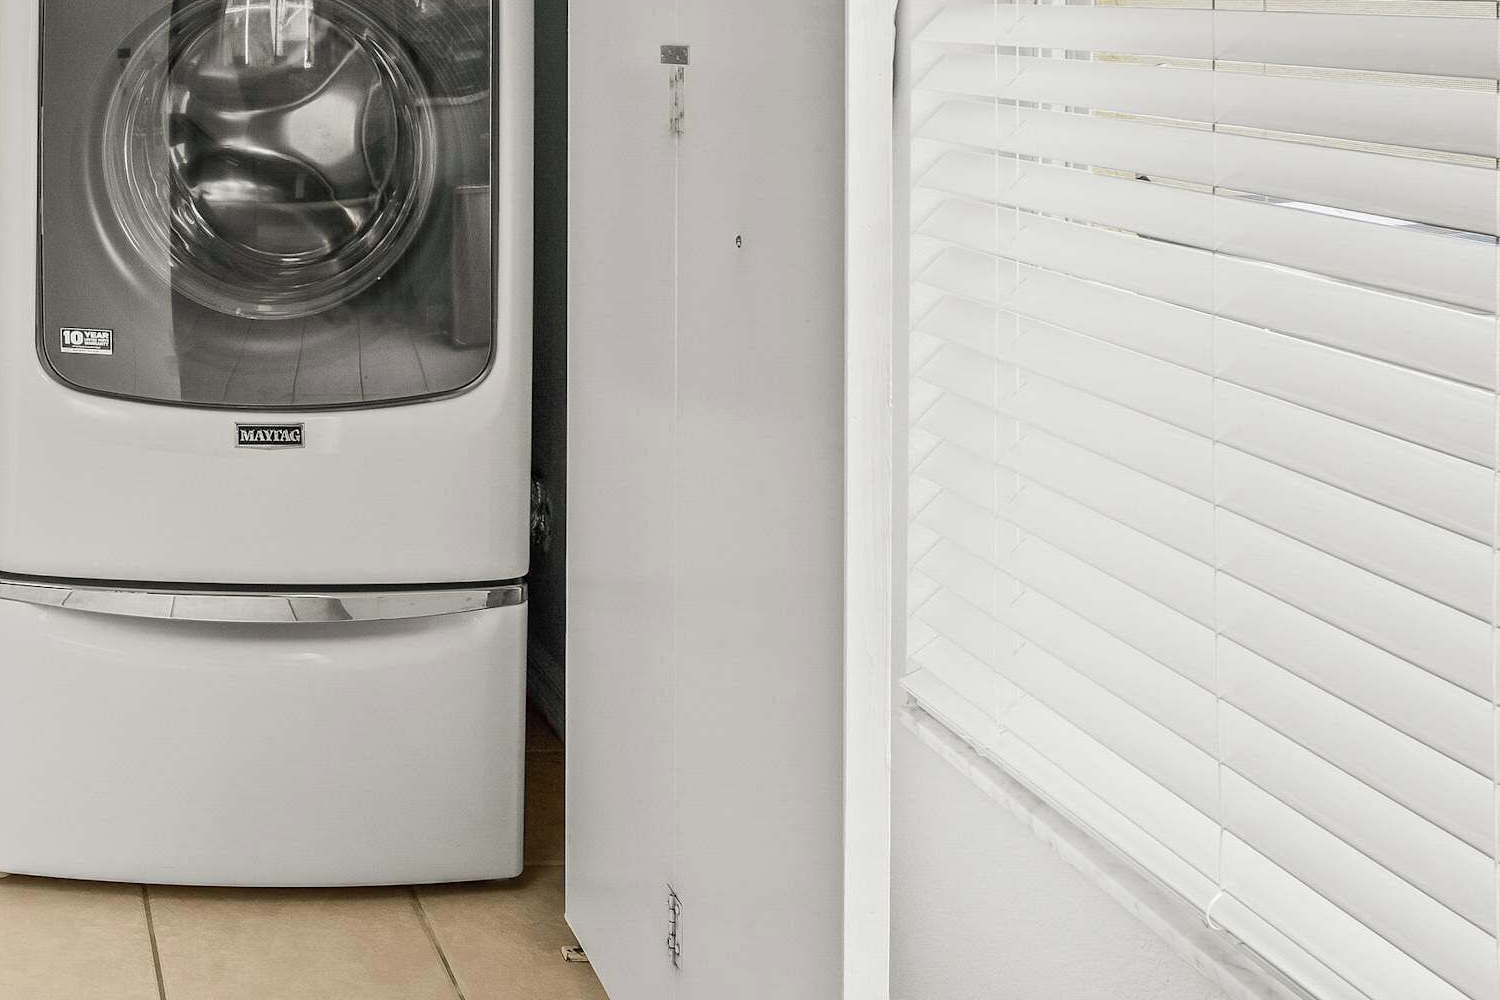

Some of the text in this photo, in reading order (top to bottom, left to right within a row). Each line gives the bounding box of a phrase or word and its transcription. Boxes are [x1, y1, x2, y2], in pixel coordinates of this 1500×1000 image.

[63, 330, 110, 345] 10 YEAR
[239, 429, 301, 442] MAYTAG
